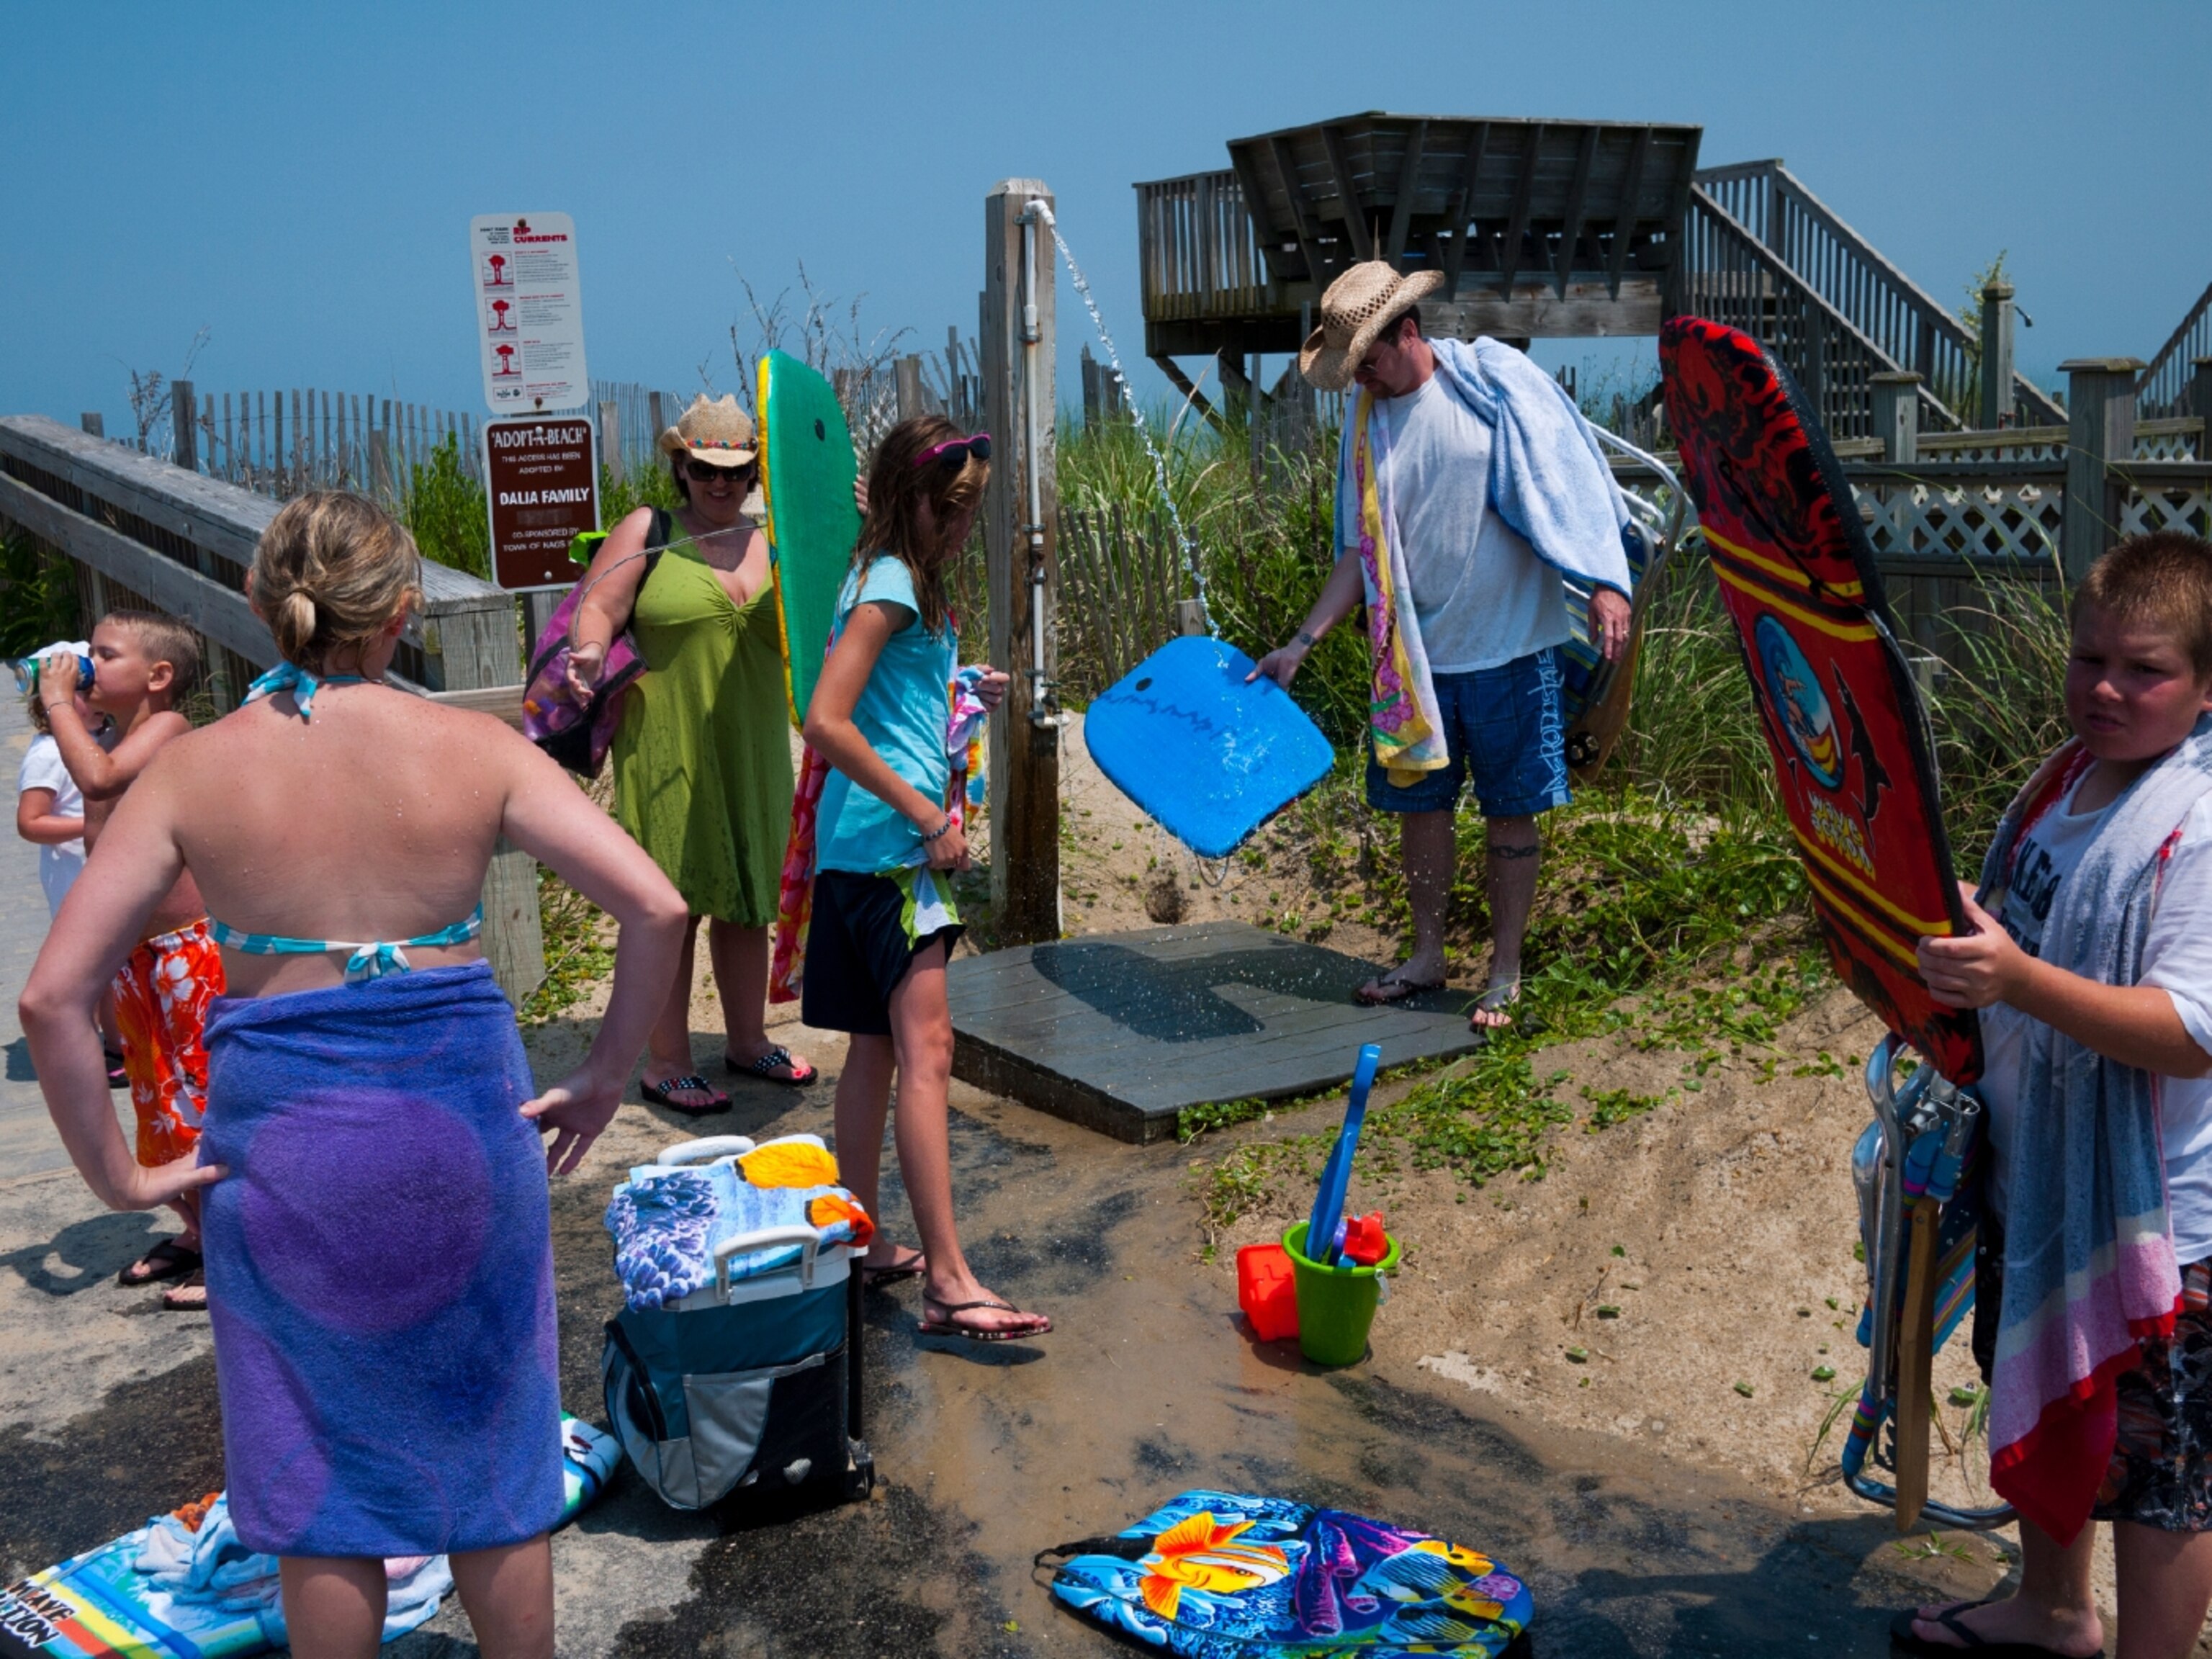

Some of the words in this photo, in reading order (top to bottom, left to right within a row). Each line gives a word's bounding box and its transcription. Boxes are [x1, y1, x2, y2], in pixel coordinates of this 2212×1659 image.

[513, 227, 531, 235] RIP
[514, 234, 567, 243] CURRENTS
[562, 451, 581, 460] BEEN
[518, 465, 552, 475] ADOPTED
[499, 490, 539, 505] DALIA
[541, 487, 589, 503] FAMILY
